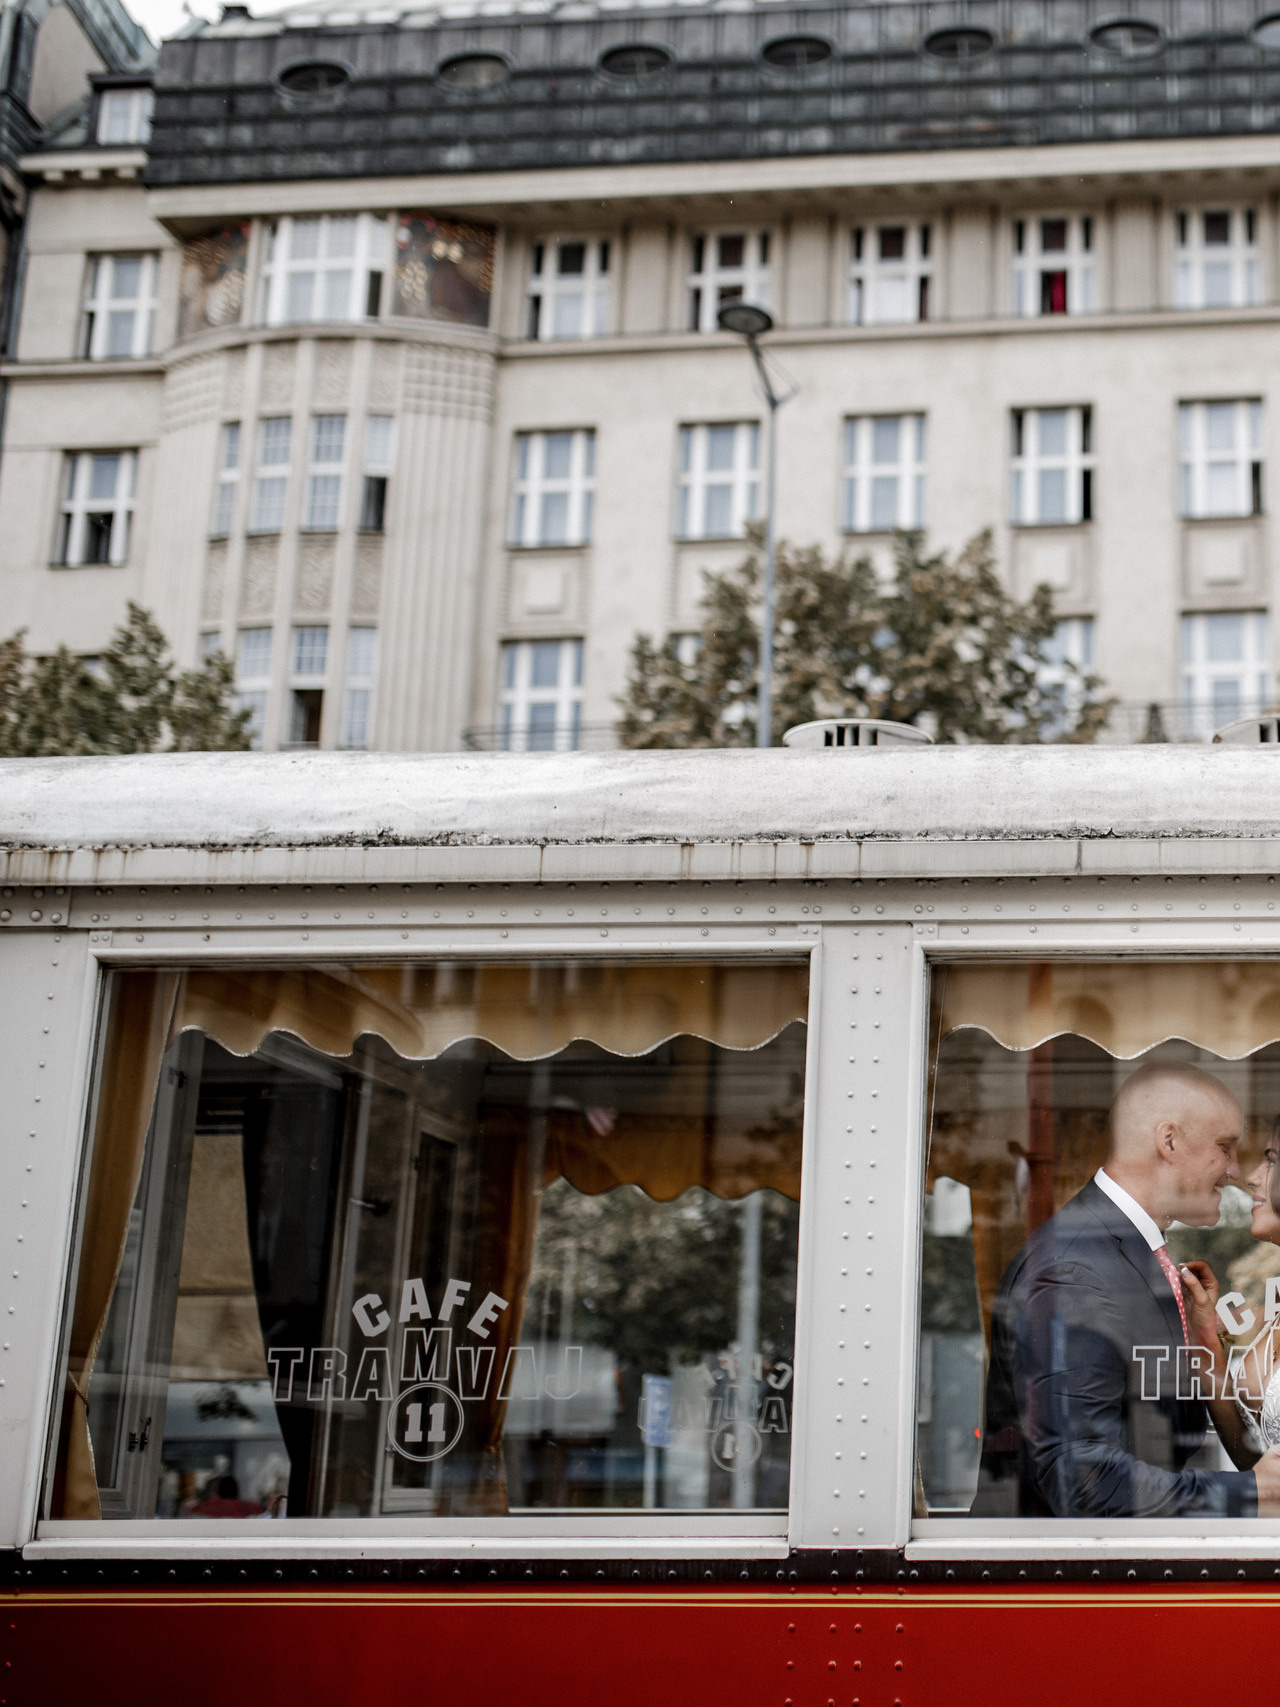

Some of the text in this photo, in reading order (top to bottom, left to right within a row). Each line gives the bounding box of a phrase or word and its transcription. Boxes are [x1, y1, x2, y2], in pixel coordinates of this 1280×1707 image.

[352, 1278, 509, 1339] CAFE
[267, 1327, 583, 1401] TRAMVAJ
[404, 1402, 446, 1442] 11
